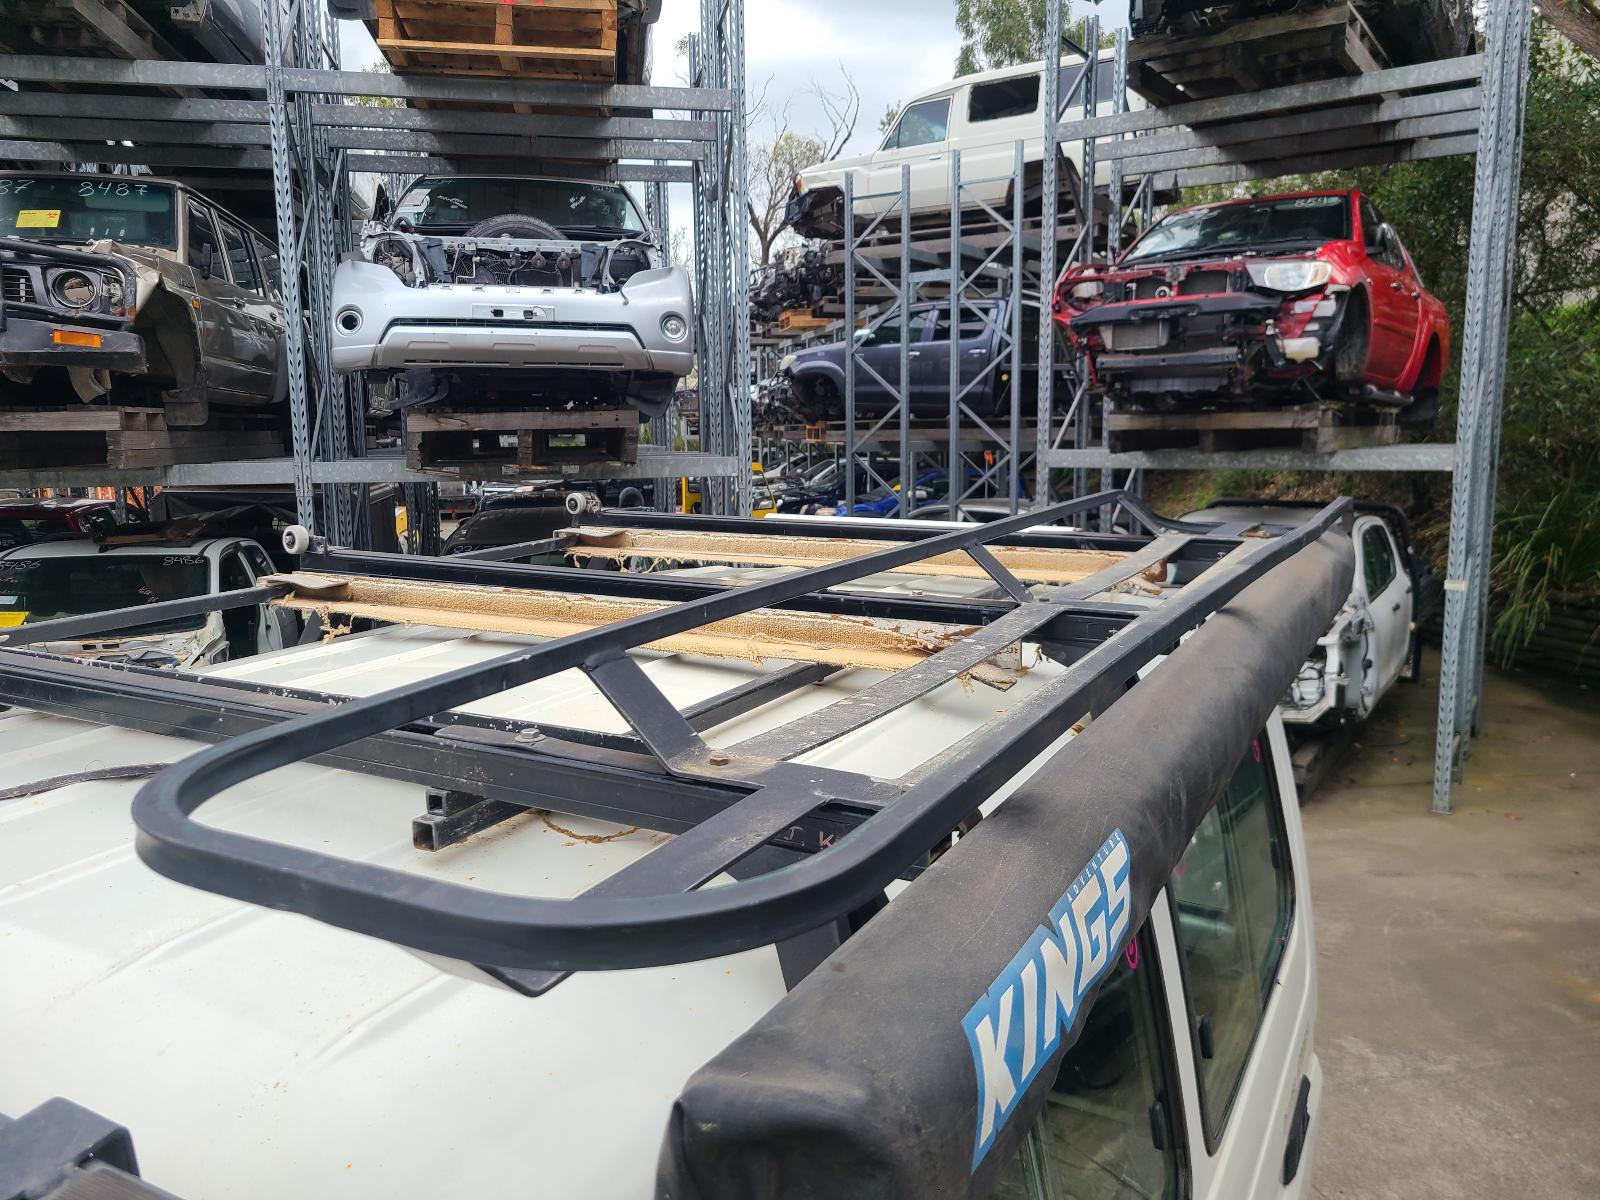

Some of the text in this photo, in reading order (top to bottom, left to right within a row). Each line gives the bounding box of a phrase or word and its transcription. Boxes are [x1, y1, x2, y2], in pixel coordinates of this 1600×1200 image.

[79, 182, 149, 197] 8487
[162, 556, 205, 566] 8486
[1066, 832, 1121, 904] ADVENTURE
[975, 841, 1130, 1149] KINGS
